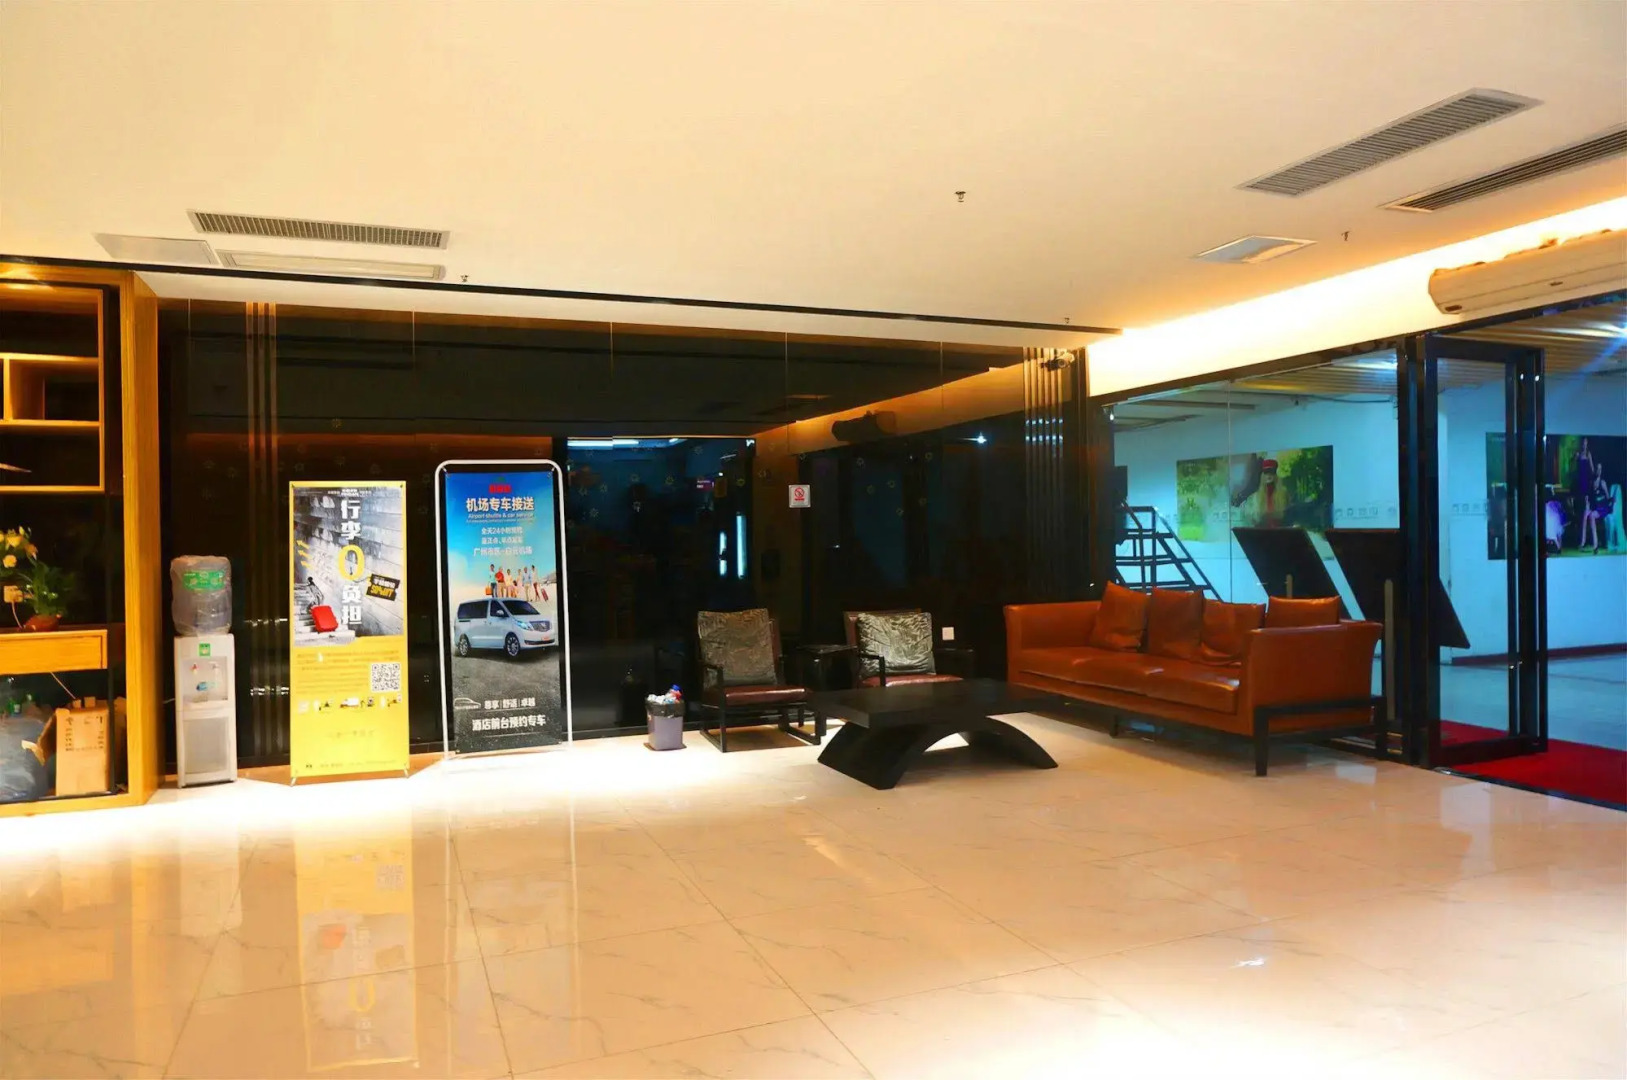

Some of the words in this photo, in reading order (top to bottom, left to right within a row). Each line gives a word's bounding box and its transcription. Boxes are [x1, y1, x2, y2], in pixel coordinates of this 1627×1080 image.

[466, 496, 535, 512] 机场专车接送
[472, 714, 546, 731] 酒店前台预约专车
